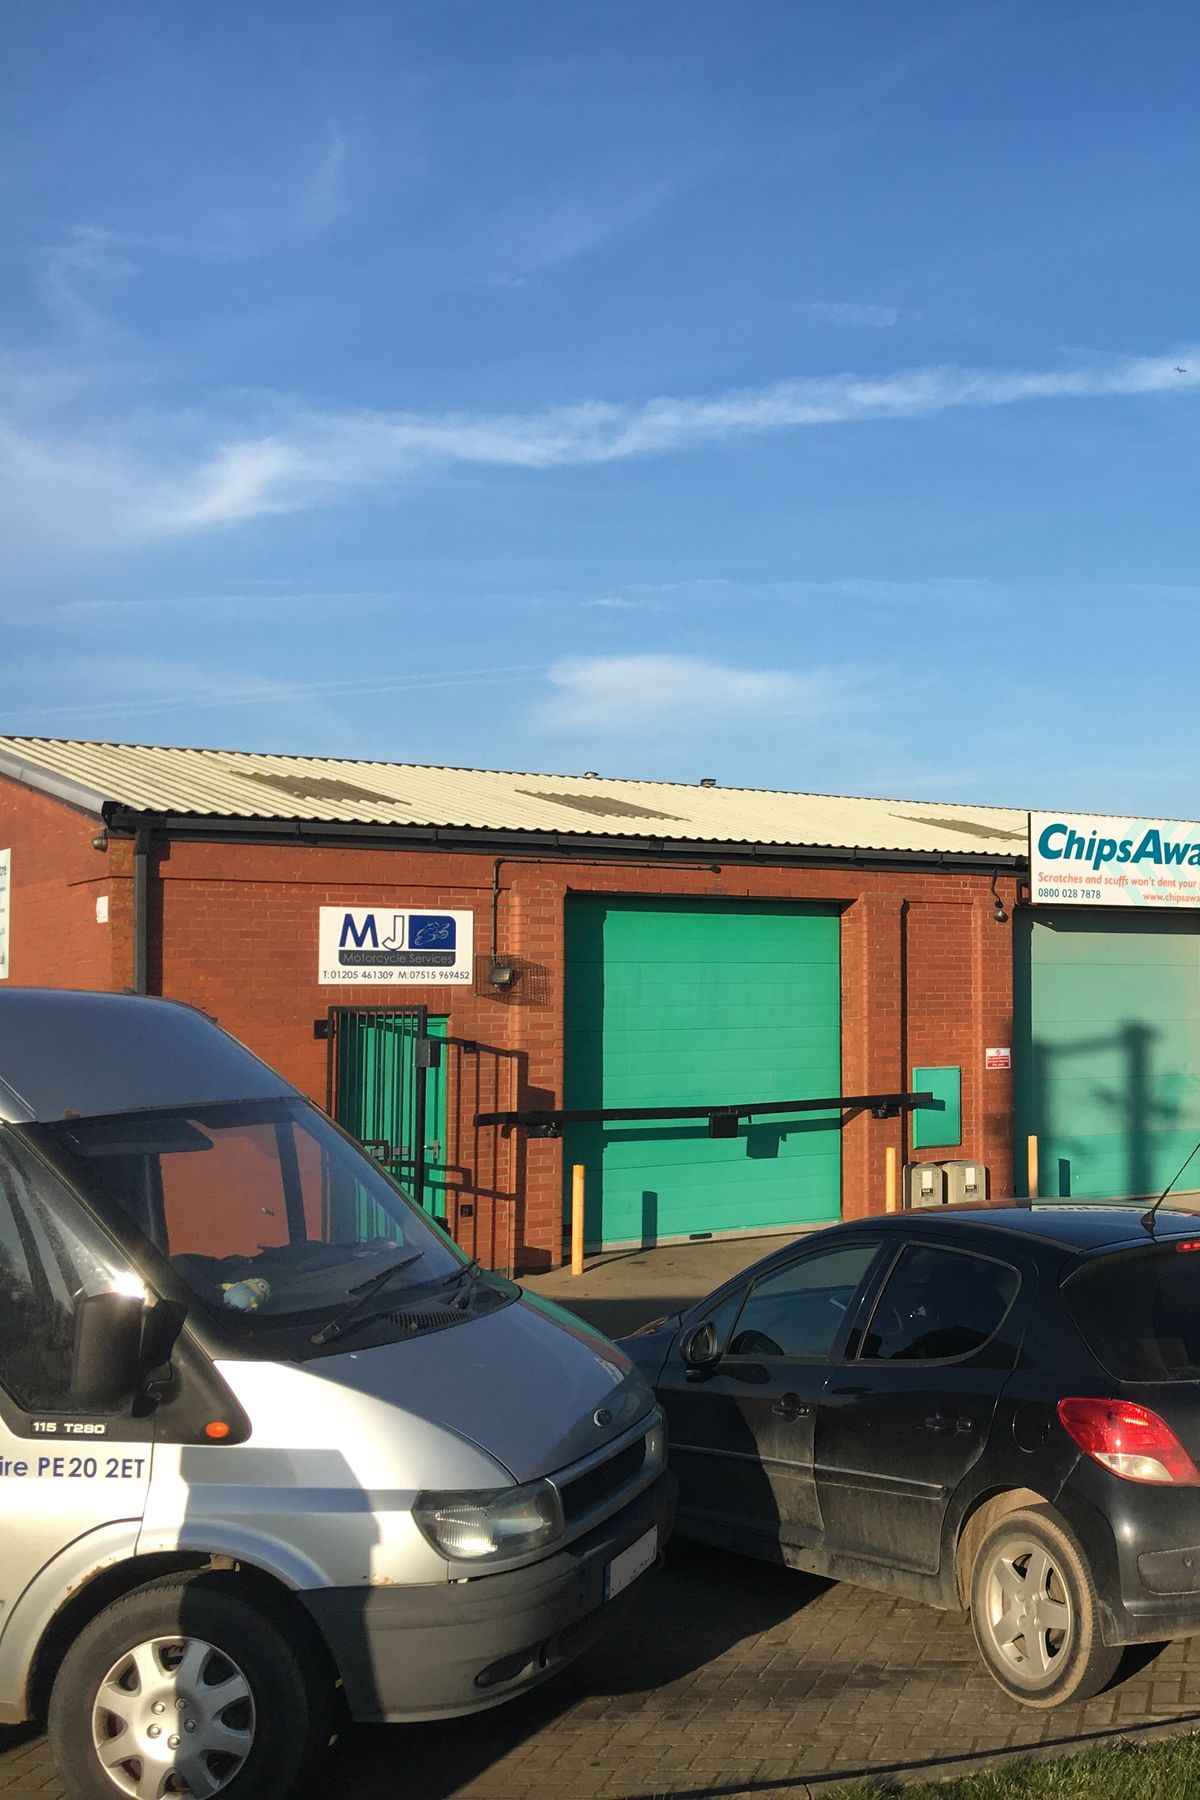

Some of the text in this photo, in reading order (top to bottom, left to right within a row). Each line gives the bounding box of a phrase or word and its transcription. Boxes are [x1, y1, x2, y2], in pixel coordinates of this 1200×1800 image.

[1038, 872, 1083, 885] Scratches
[1085, 874, 1102, 885] and
[1104, 875, 1129, 888] scuffs
[1131, 876, 1155, 887] won't
[1157, 876, 1176, 888] dent
[1178, 879, 1197, 891] your
[1038, 888, 1101, 900] 0800 028 7878
[343, 953, 453, 965] Motorcycle Services
[361, 970, 394, 980] 461309
[438, 971, 470, 981] 969452
[33, 1421, 106, 1434] 115 T280
[105, 1458, 145, 1479] 2ET
